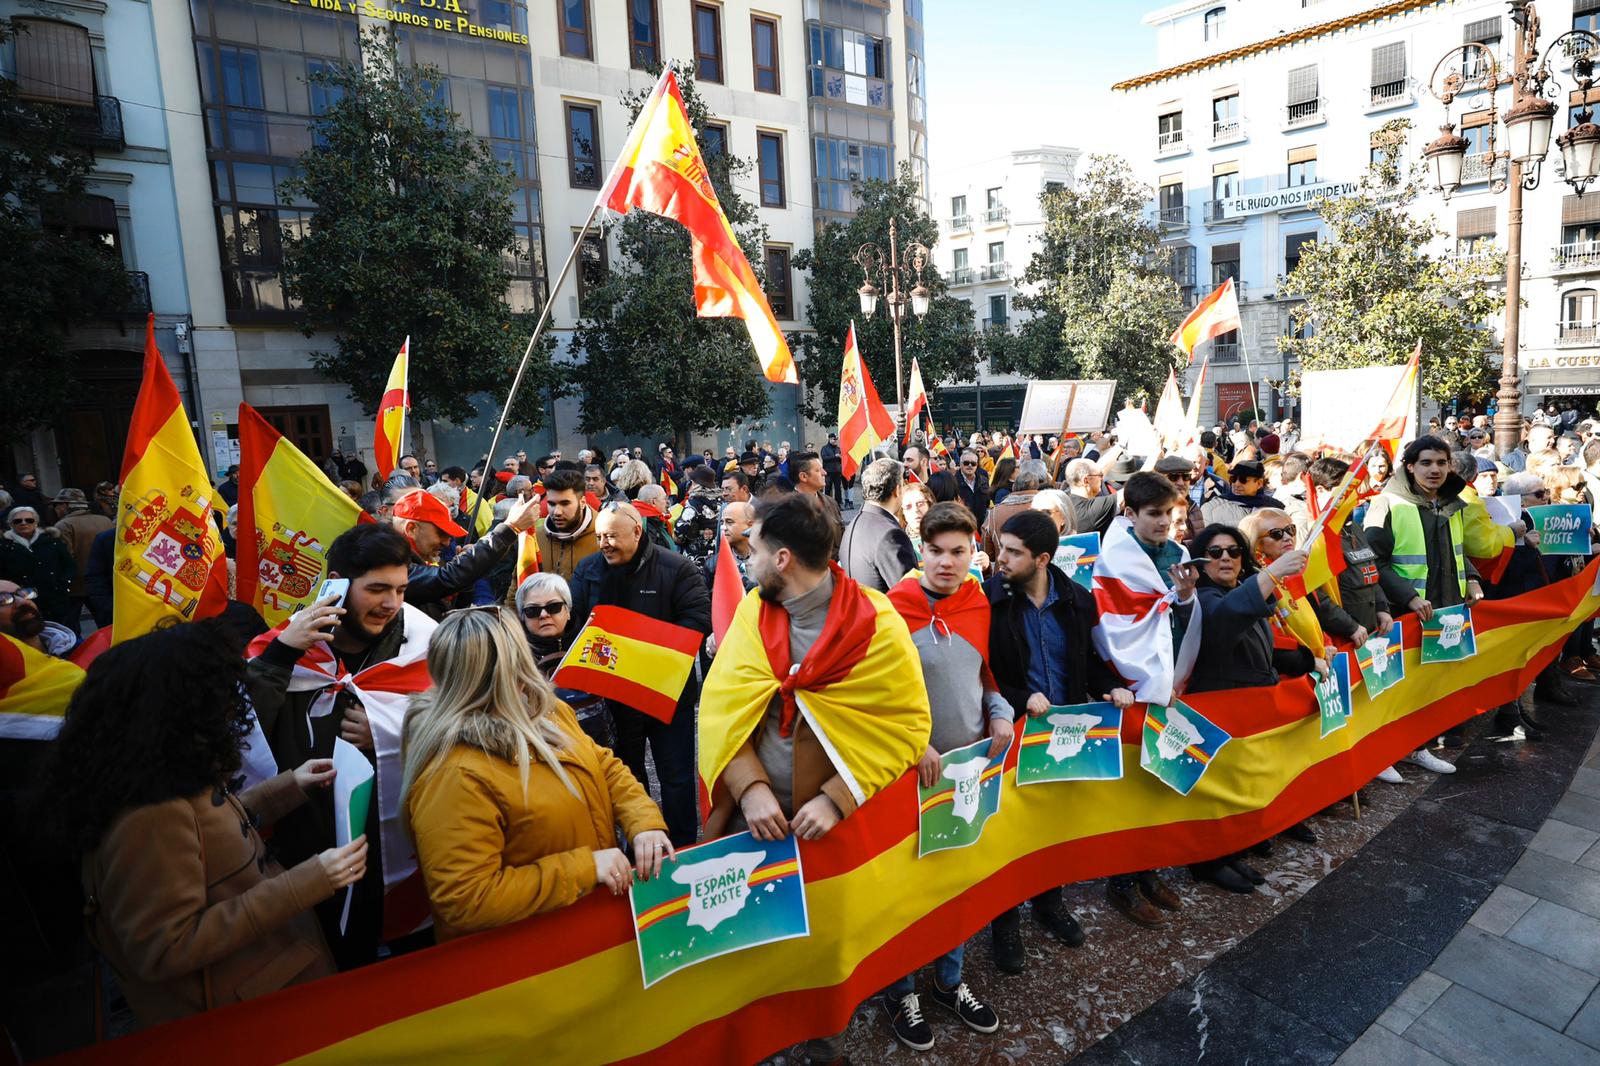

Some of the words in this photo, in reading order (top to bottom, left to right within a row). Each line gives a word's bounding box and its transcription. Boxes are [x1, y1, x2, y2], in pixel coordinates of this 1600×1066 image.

[364, 1, 429, 27] SEGUROS
[435, 18, 452, 31] DE
[457, 17, 528, 45] PENSIONES
[1235, 198, 1246, 212] EL
[1248, 194, 1278, 211] RUIDO
[1281, 190, 1301, 206] NOS
[1528, 357, 1551, 369] LA
[1539, 386, 1551, 395] LA
[1552, 386, 1585, 395] CUEVA
[1544, 512, 1581, 531] ESPAÑA
[1543, 531, 1574, 545] EXISTE
[1055, 723, 1087, 736] ESPAÑA
[1165, 724, 1191, 745] ESPAÑA
[695, 867, 746, 898] ESPAÑA
[702, 885, 742, 910] EXISTE
